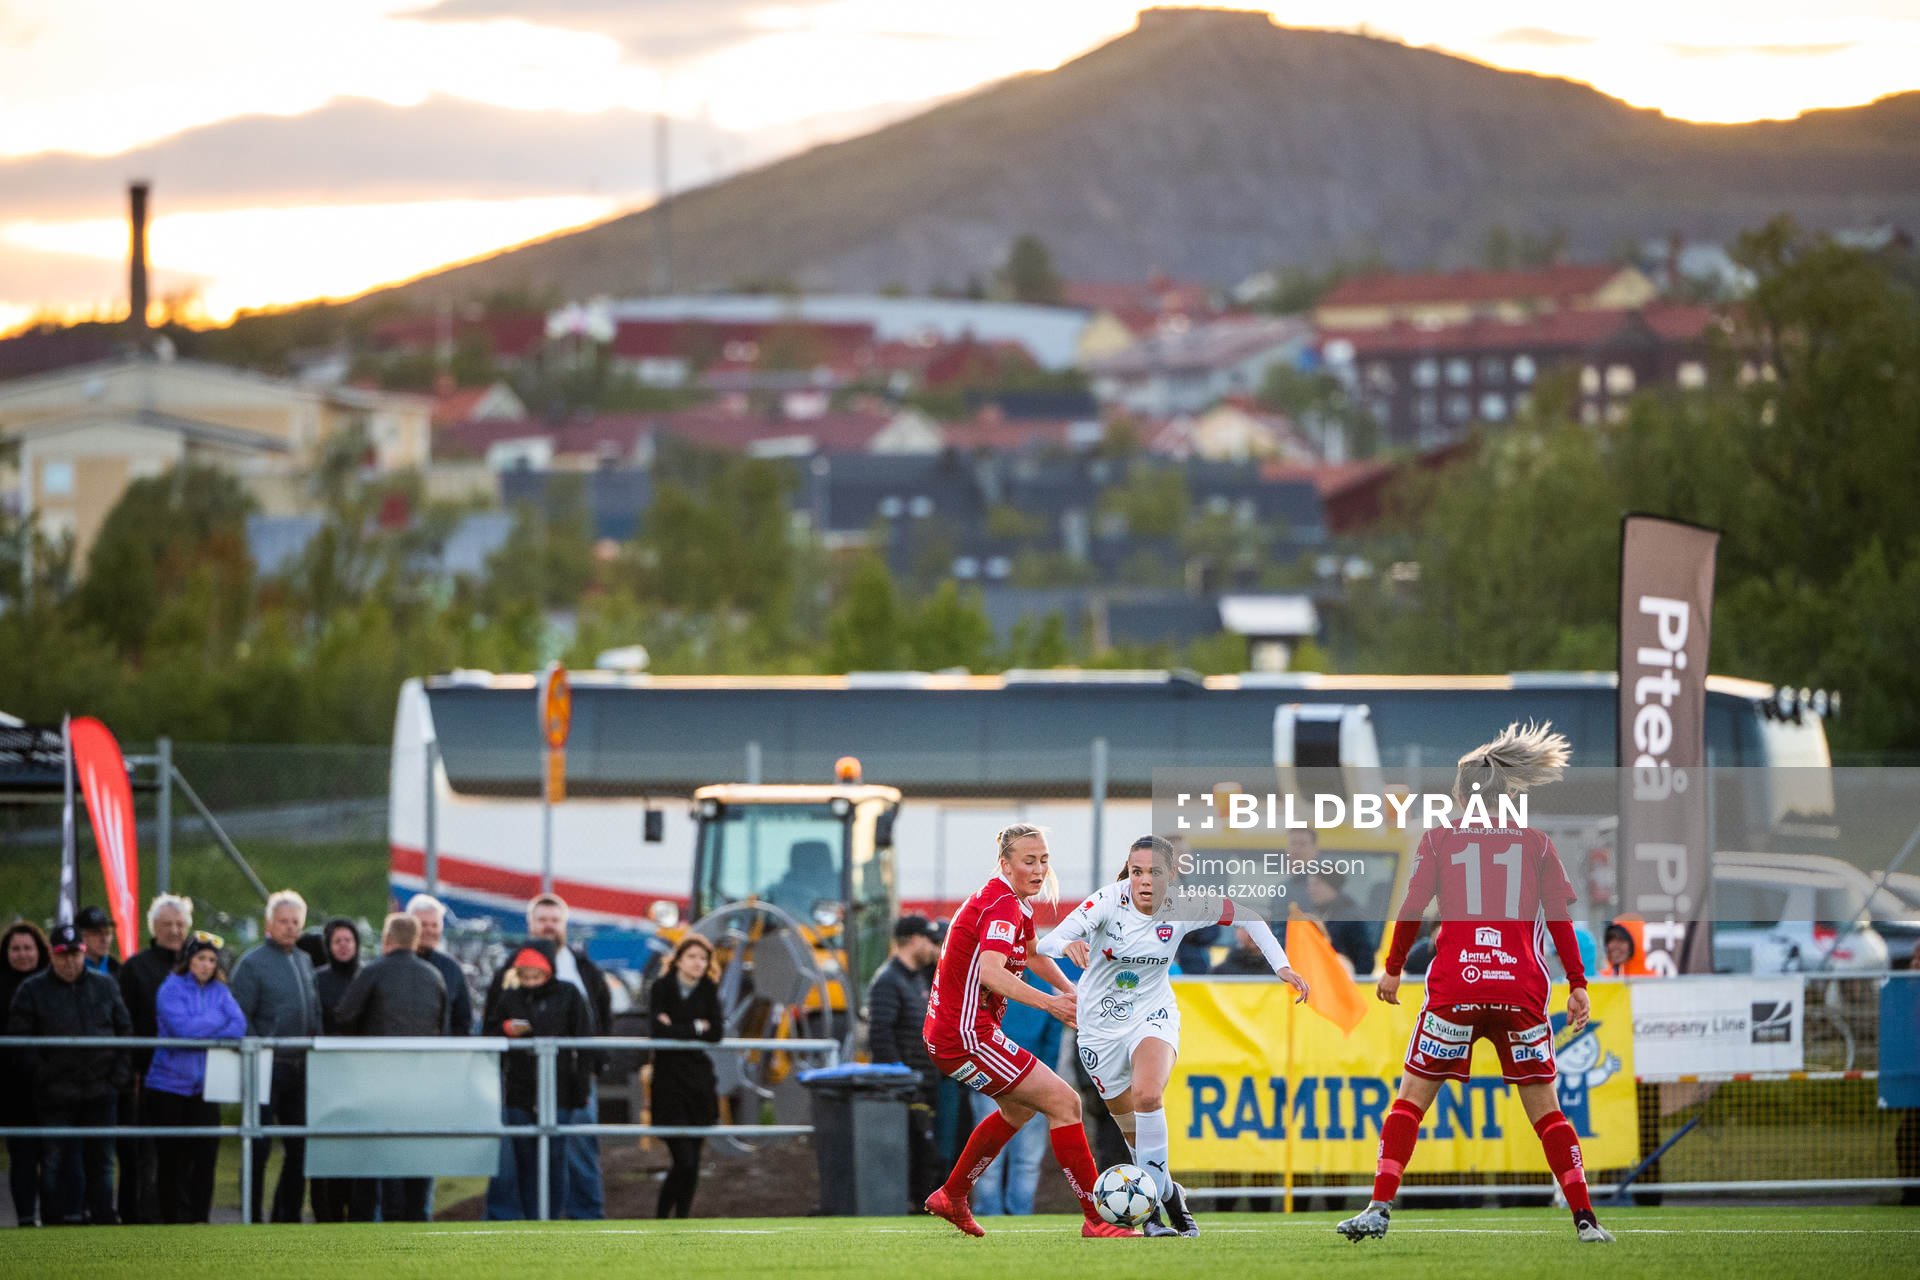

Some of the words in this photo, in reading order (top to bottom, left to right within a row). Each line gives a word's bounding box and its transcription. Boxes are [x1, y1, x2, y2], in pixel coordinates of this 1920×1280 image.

[1633, 595, 1689, 801] Piteå
[1451, 842, 1523, 919] 11
[1634, 842, 1690, 977] Pite
[1420, 1040, 1467, 1058] ahlsell
[1633, 1019, 1708, 1037] Company
[1713, 1018, 1746, 1033] Line
[1515, 1046, 1544, 1061] ahls
